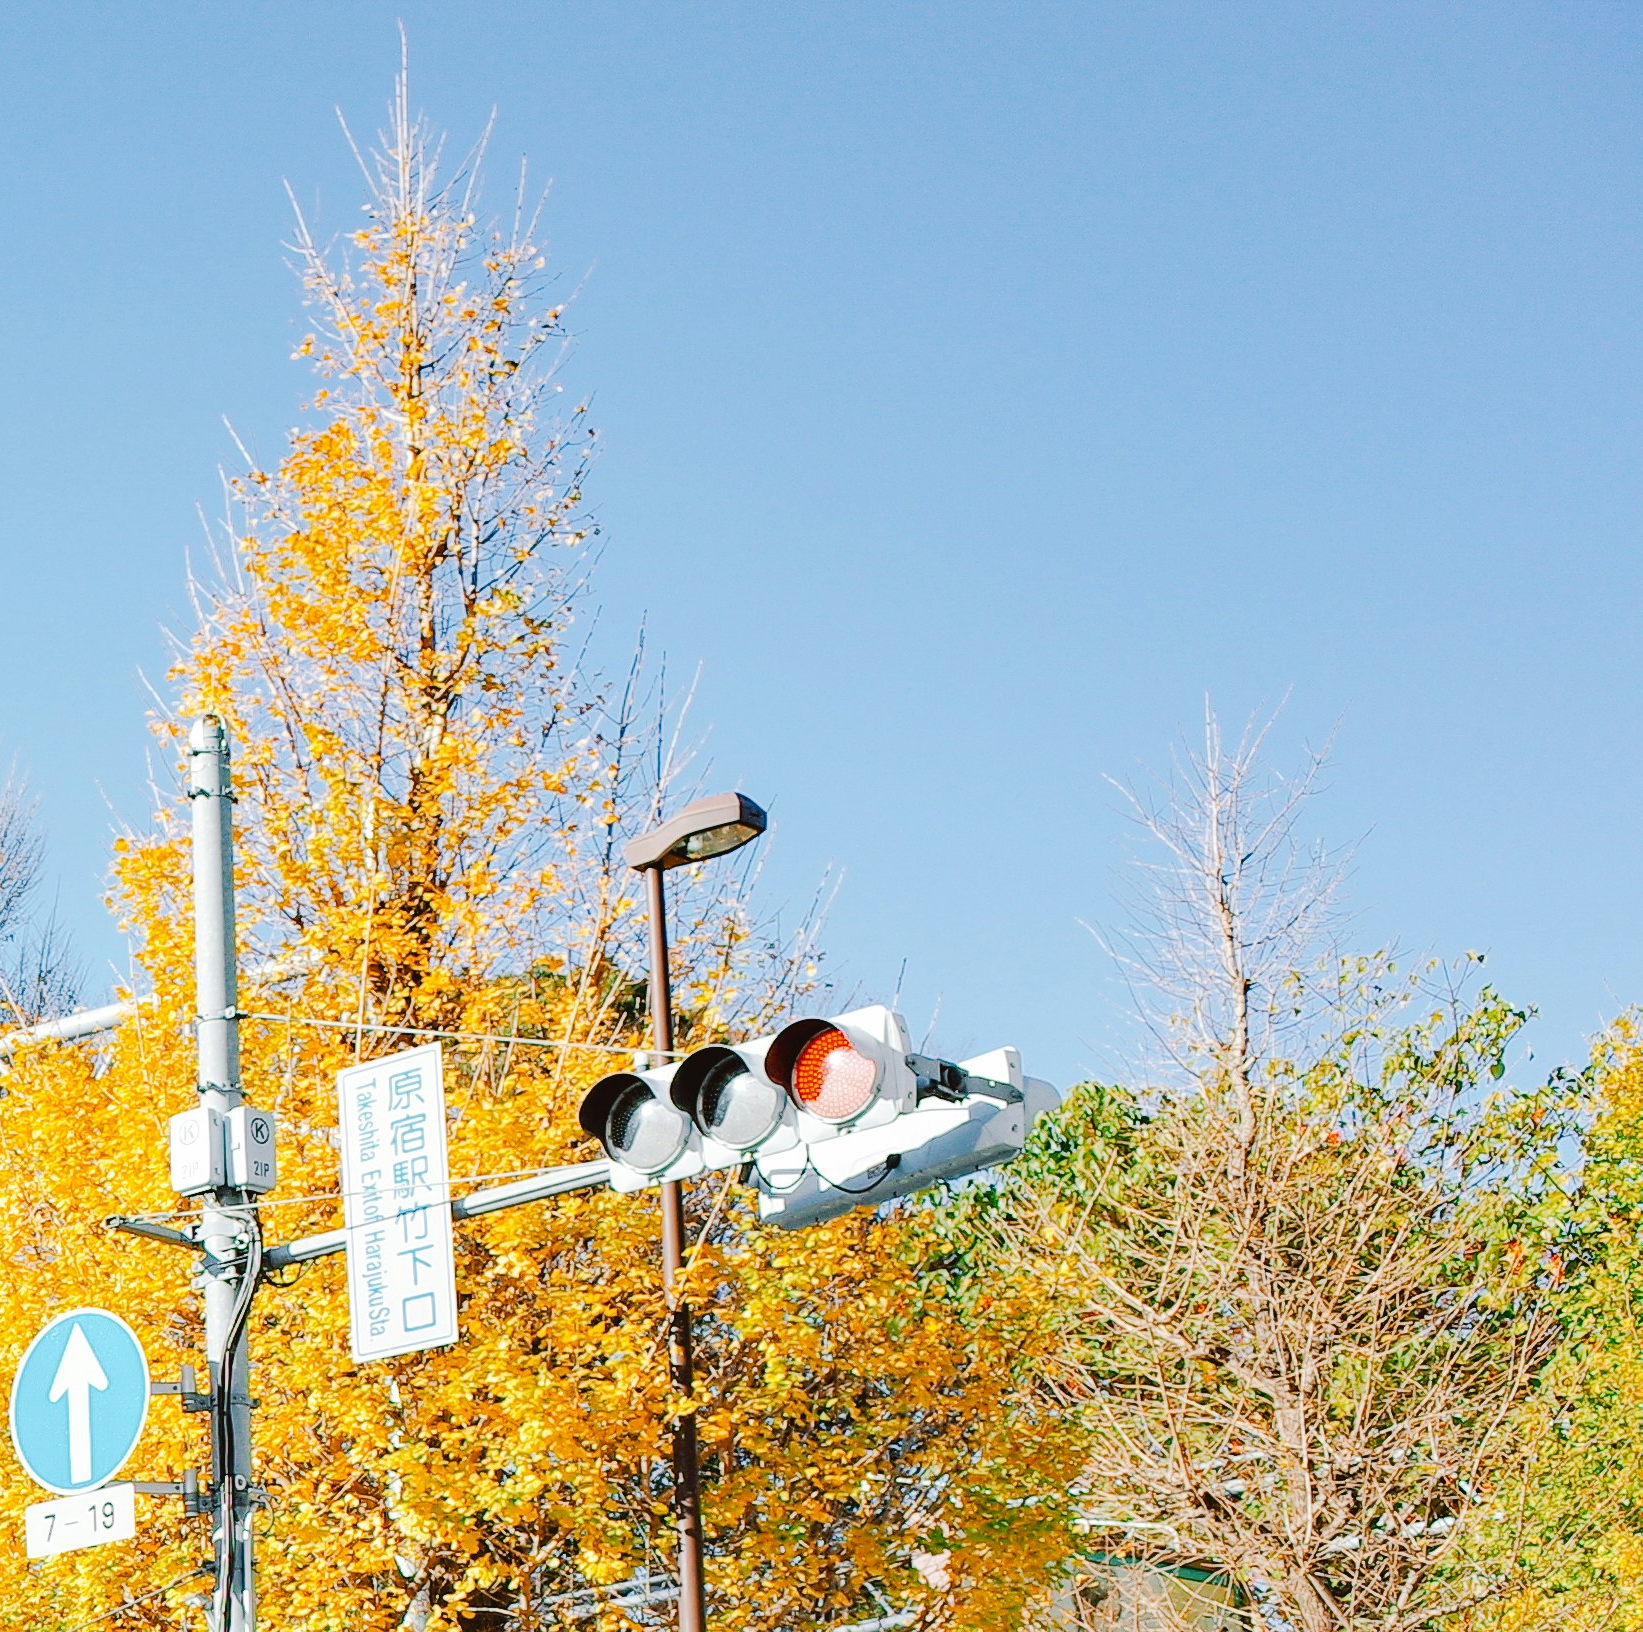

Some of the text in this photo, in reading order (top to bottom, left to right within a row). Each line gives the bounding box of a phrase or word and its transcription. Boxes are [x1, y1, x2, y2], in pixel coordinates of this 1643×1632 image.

[356, 1077, 381, 1163] Takeshita
[387, 1067, 437, 1333] 原宿駅竹下口
[363, 1229, 389, 1306] Harajuku
